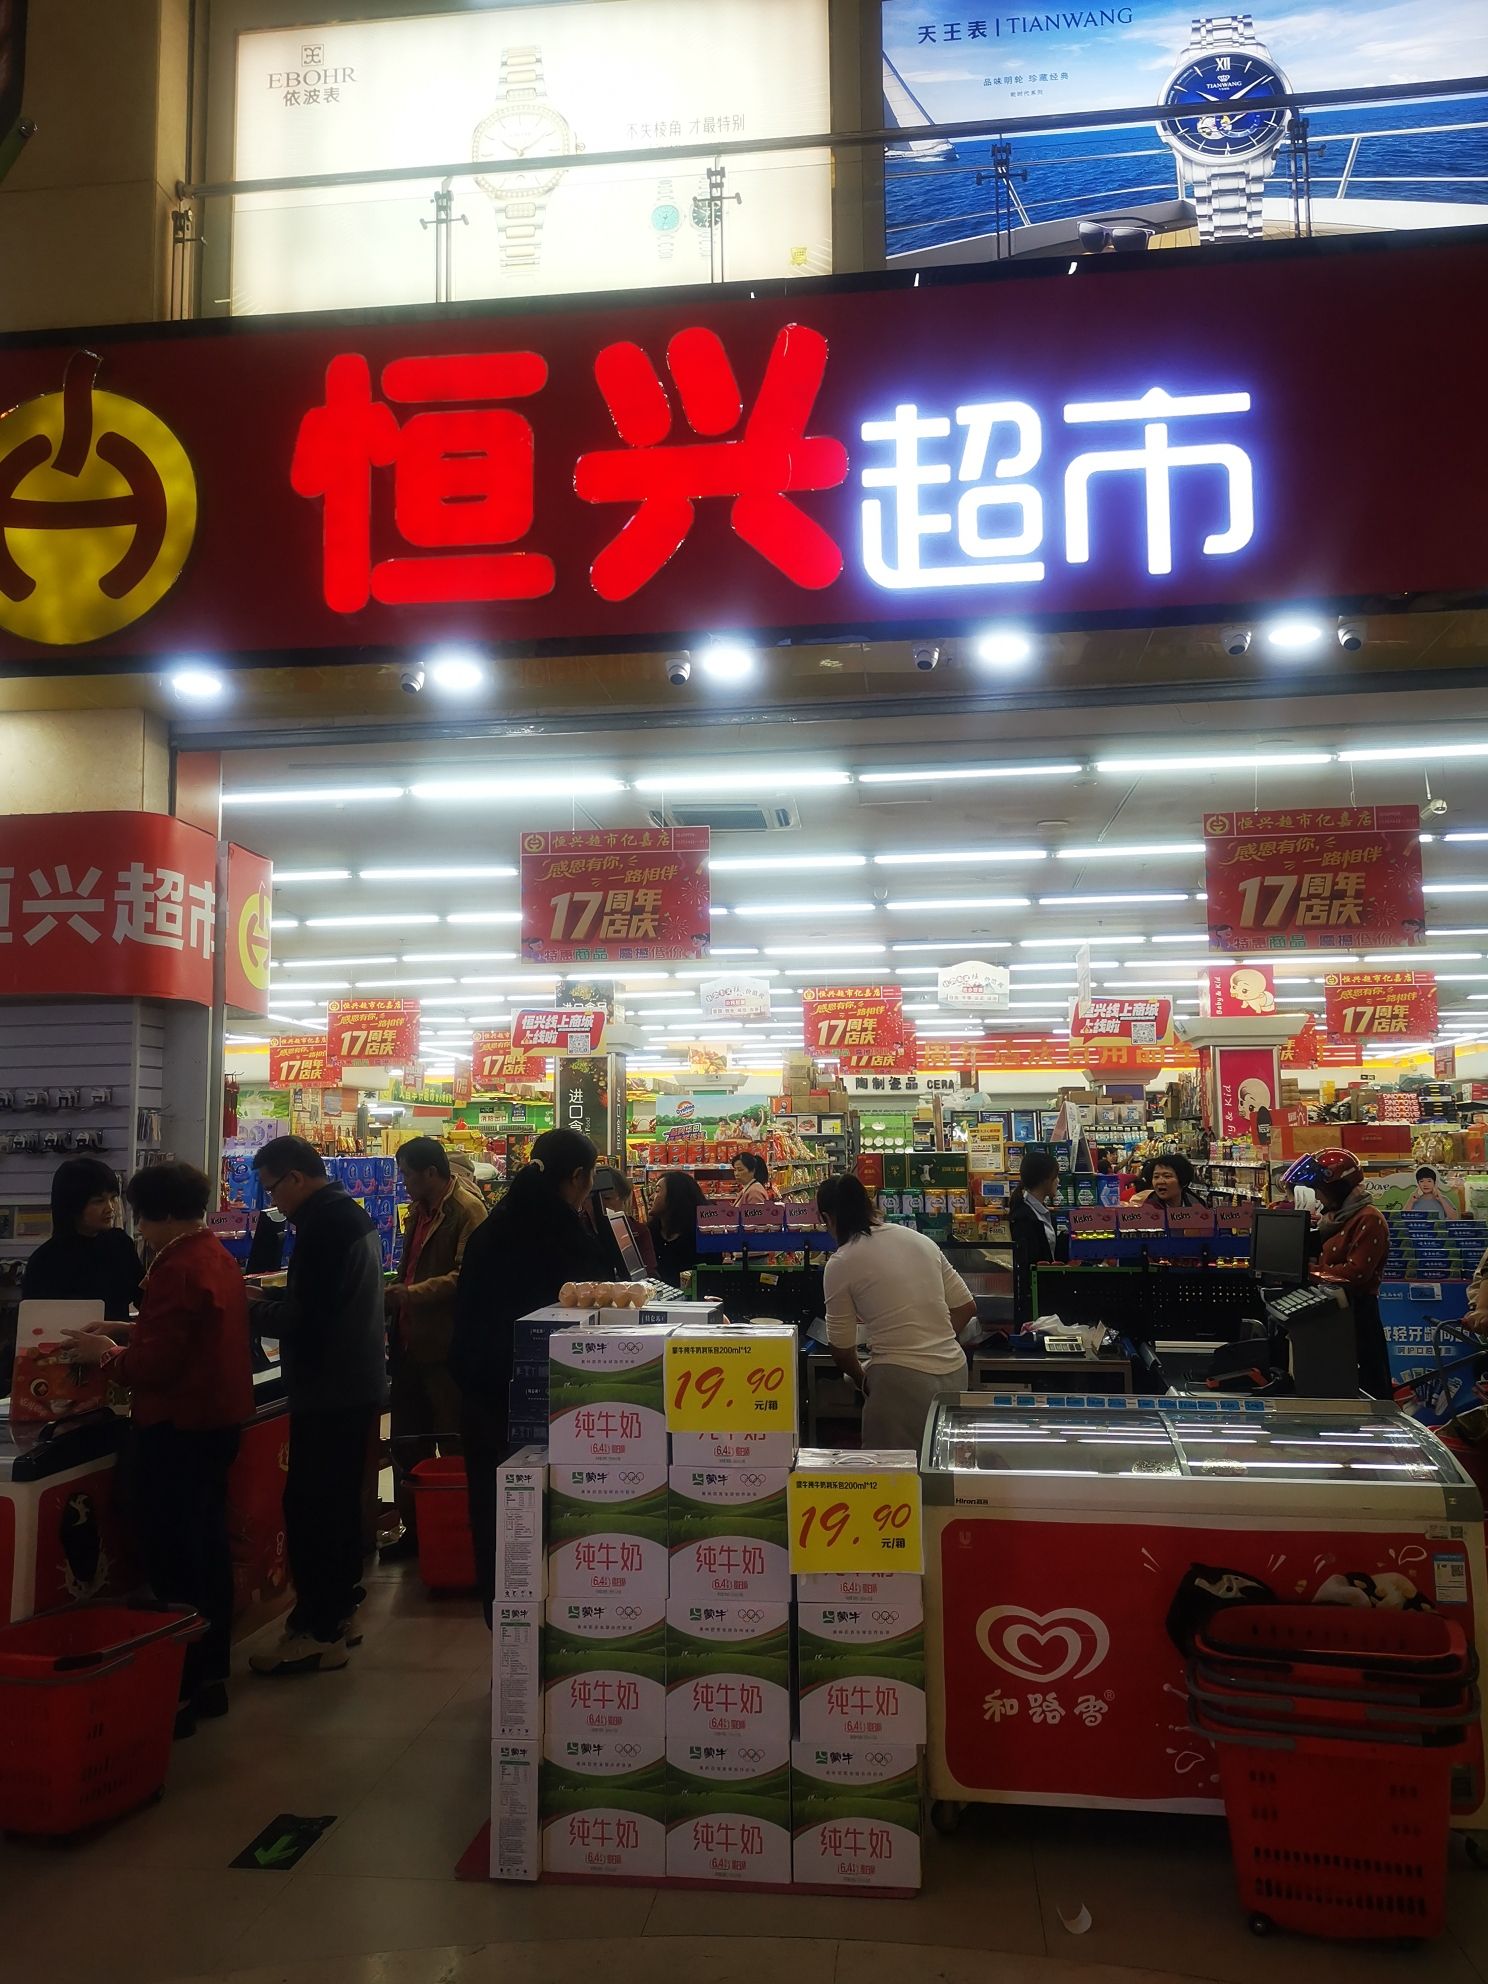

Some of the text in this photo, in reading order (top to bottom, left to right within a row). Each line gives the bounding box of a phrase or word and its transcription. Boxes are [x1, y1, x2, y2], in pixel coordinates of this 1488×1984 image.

[918, 7, 1132, 44] 天王表 TIANWANG
[267, 66, 357, 89] EBOHR
[1206, 81, 1242, 90] TIANWANG
[283, 87, 340, 106] 依波表
[626, 113, 745, 139] 不失棱角 才最特别
[290, 321, 1254, 613] 恒兴超市
[1303, 846, 1384, 868] 一路相伴
[608, 864, 679, 885] 一路相伴
[1300, 872, 1366, 899] 周年
[0, 863, 215, 959] 兴超市
[604, 889, 663, 913] 周年
[1238, 875, 1299, 929] 17
[550, 891, 604, 940] 17
[1296, 899, 1364, 926] 店庆
[601, 914, 659, 939] 店庆
[522, 1014, 594, 1029] 恒兴线上商城
[1342, 1006, 1375, 1033] 17
[1374, 1005, 1410, 1018] 周年
[818, 1020, 847, 1046] 17
[846, 1018, 877, 1031] 周年
[1373, 1018, 1408, 1032] 店庆
[340, 1031, 368, 1056] 17
[368, 1029, 397, 1042] 周年
[521, 1030, 558, 1045] 上线啦
[844, 1032, 876, 1045] 店庆
[365, 1042, 395, 1055] 店庆
[280, 1060, 301, 1080] 17
[301, 1059, 323, 1070] 周年
[483, 1055, 504, 1075] 17
[502, 1065, 526, 1075] 店庆
[870, 1056, 895, 1066] 店庆
[299, 1070, 321, 1080] 店庆
[855, 1076, 955, 1090] 陶制瓷品 CERA
[1365, 1181, 1390, 1191] Dove
[585, 1343, 607, 1354] 蒙牛
[754, 1400, 778, 1411] 元/箱
[575, 1410, 642, 1439] 纯牛奶
[585, 1472, 607, 1483] 蒙牛
[706, 1474, 728, 1486] 蒙牛
[881, 1538, 906, 1549] 元/箱
[575, 1542, 642, 1571] 纯牛奶
[696, 1545, 764, 1574] 纯牛奶
[582, 1606, 605, 1618] 蒙牛
[703, 1609, 727, 1622] 蒙牛
[837, 1611, 860, 1624] 蒙牛
[571, 1679, 639, 1710] 纯牛奶
[693, 1682, 762, 1714] 纯牛奶
[827, 1685, 898, 1716] 纯牛奶
[982, 1688, 1109, 1727] 和路雪
[581, 1743, 603, 1756] 蒙牛
[704, 1747, 726, 1760] 蒙牛
[830, 1752, 853, 1764] 蒙牛
[569, 1816, 639, 1848] 纯牛奶
[694, 1821, 763, 1854] 纯牛奶
[820, 1826, 892, 1859] 纯牛奶
